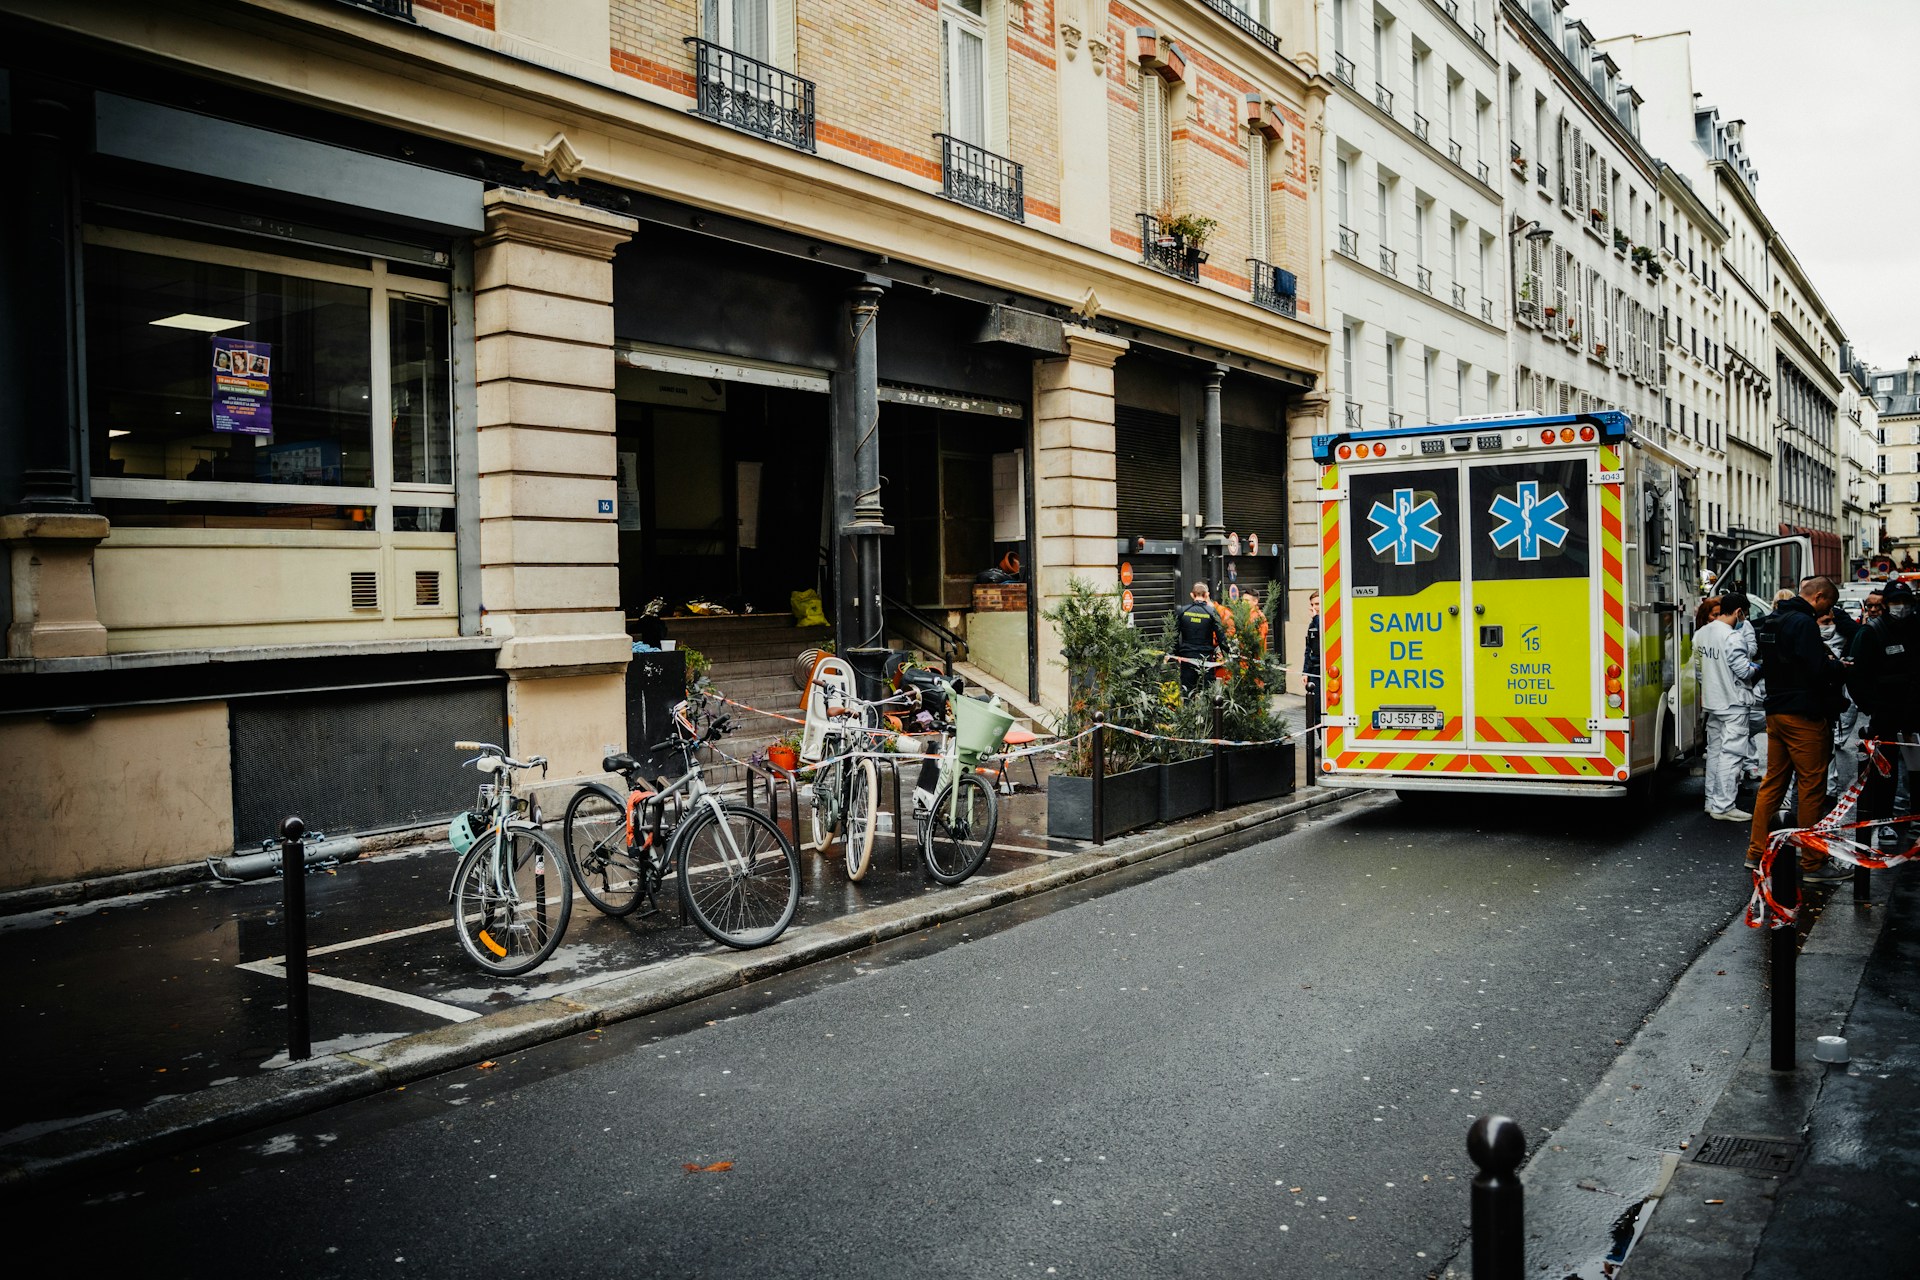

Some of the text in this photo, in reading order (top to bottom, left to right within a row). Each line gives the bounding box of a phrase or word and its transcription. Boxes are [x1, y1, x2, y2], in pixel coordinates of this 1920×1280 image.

[1600, 473, 1620, 481] 4043
[601, 501, 610, 511] 16
[1369, 612, 1443, 633] SAMU
[1524, 637, 1540, 651] 15
[1390, 641, 1424, 661] DE
[1697, 646, 1720, 660] SAMU
[1510, 663, 1551, 675] SMUR
[1370, 669, 1445, 689] PARIS
[1507, 678, 1555, 690] HOTEL
[1514, 694, 1548, 704] DIEU
